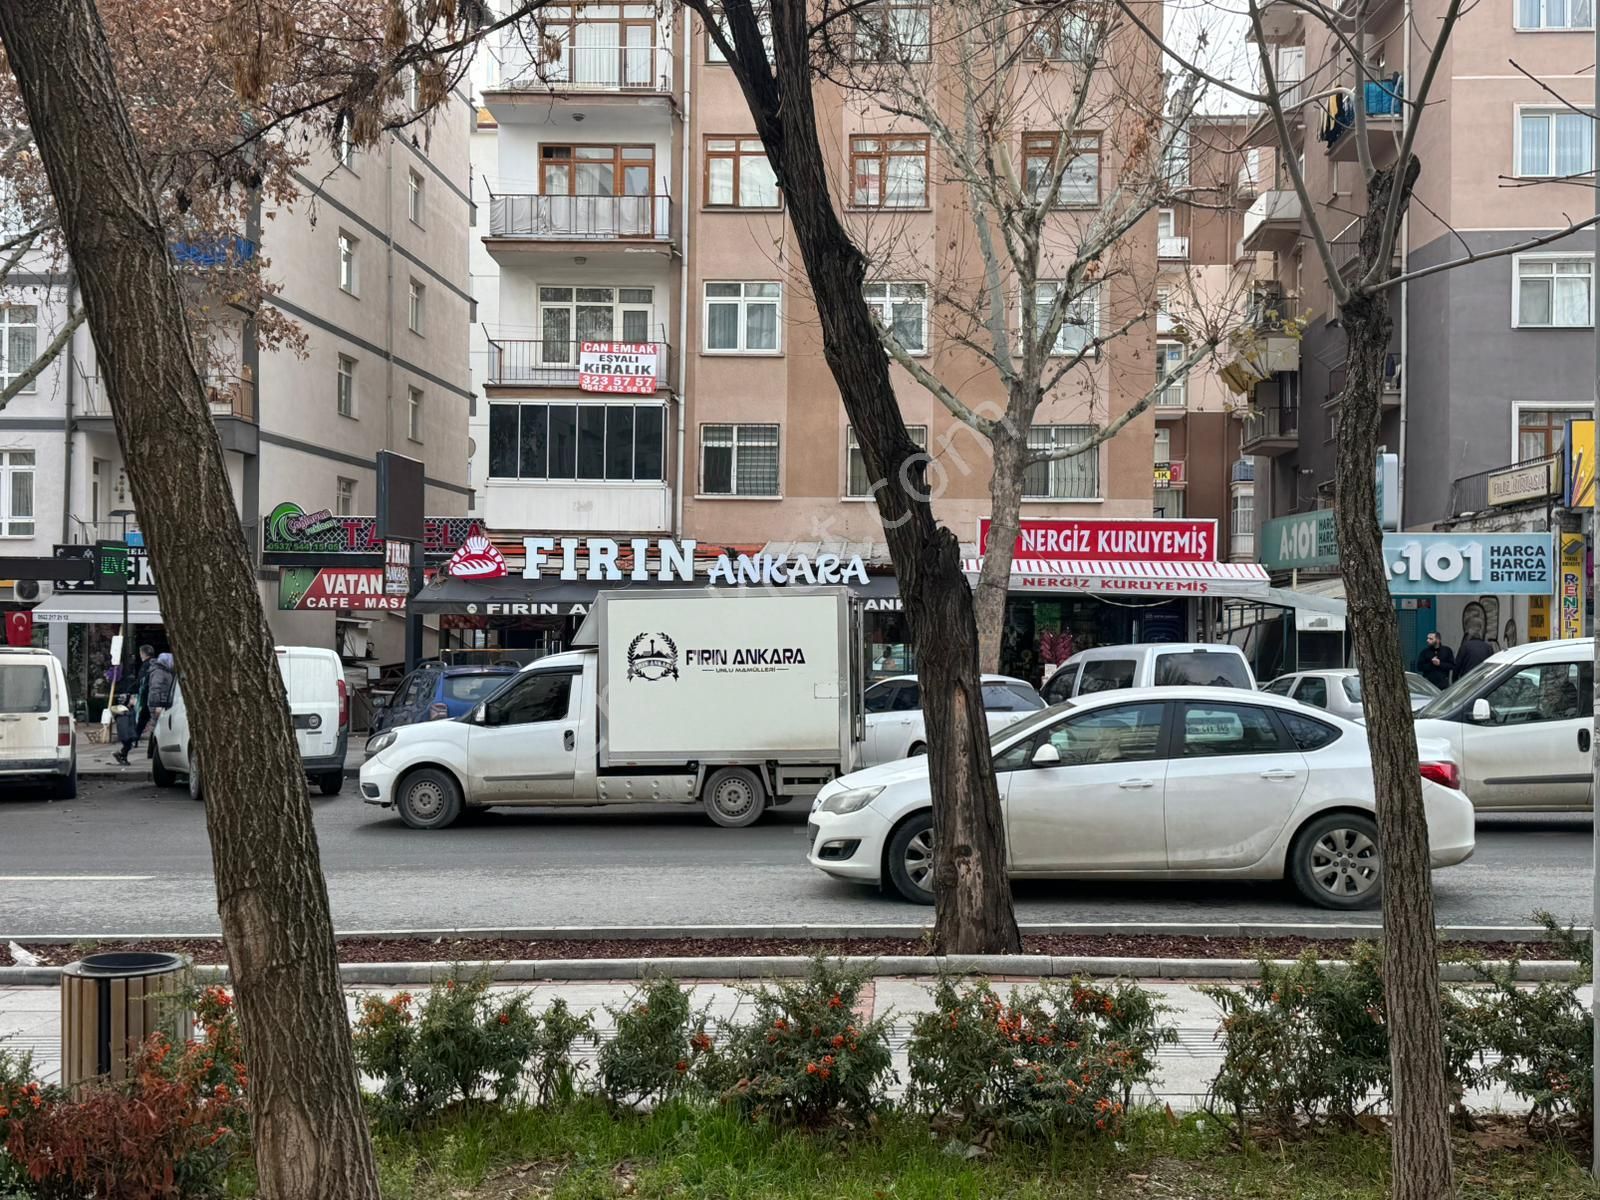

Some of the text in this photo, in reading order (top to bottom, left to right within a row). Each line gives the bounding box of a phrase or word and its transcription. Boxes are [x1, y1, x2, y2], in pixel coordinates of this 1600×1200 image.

[583, 342, 654, 354] CAN EMLAK
[599, 354, 639, 363] EŞYALI
[582, 375, 654, 387] 323 57 57
[342, 522, 484, 549] TAELA
[1021, 524, 1208, 559] NERGİZ KURUYEMİŞ
[1490, 545, 1546, 557] HARCA
[522, 536, 872, 586] FIRIN ANKARA
[1490, 558, 1546, 570] HARCA
[322, 574, 384, 595] VATAN
[1022, 577, 1209, 594] NERGİZ KURUYEMİŞ
[306, 597, 349, 608] CAFE
[486, 603, 558, 615] FIRIN
[686, 648, 806, 665] FIRIN ANKARA
